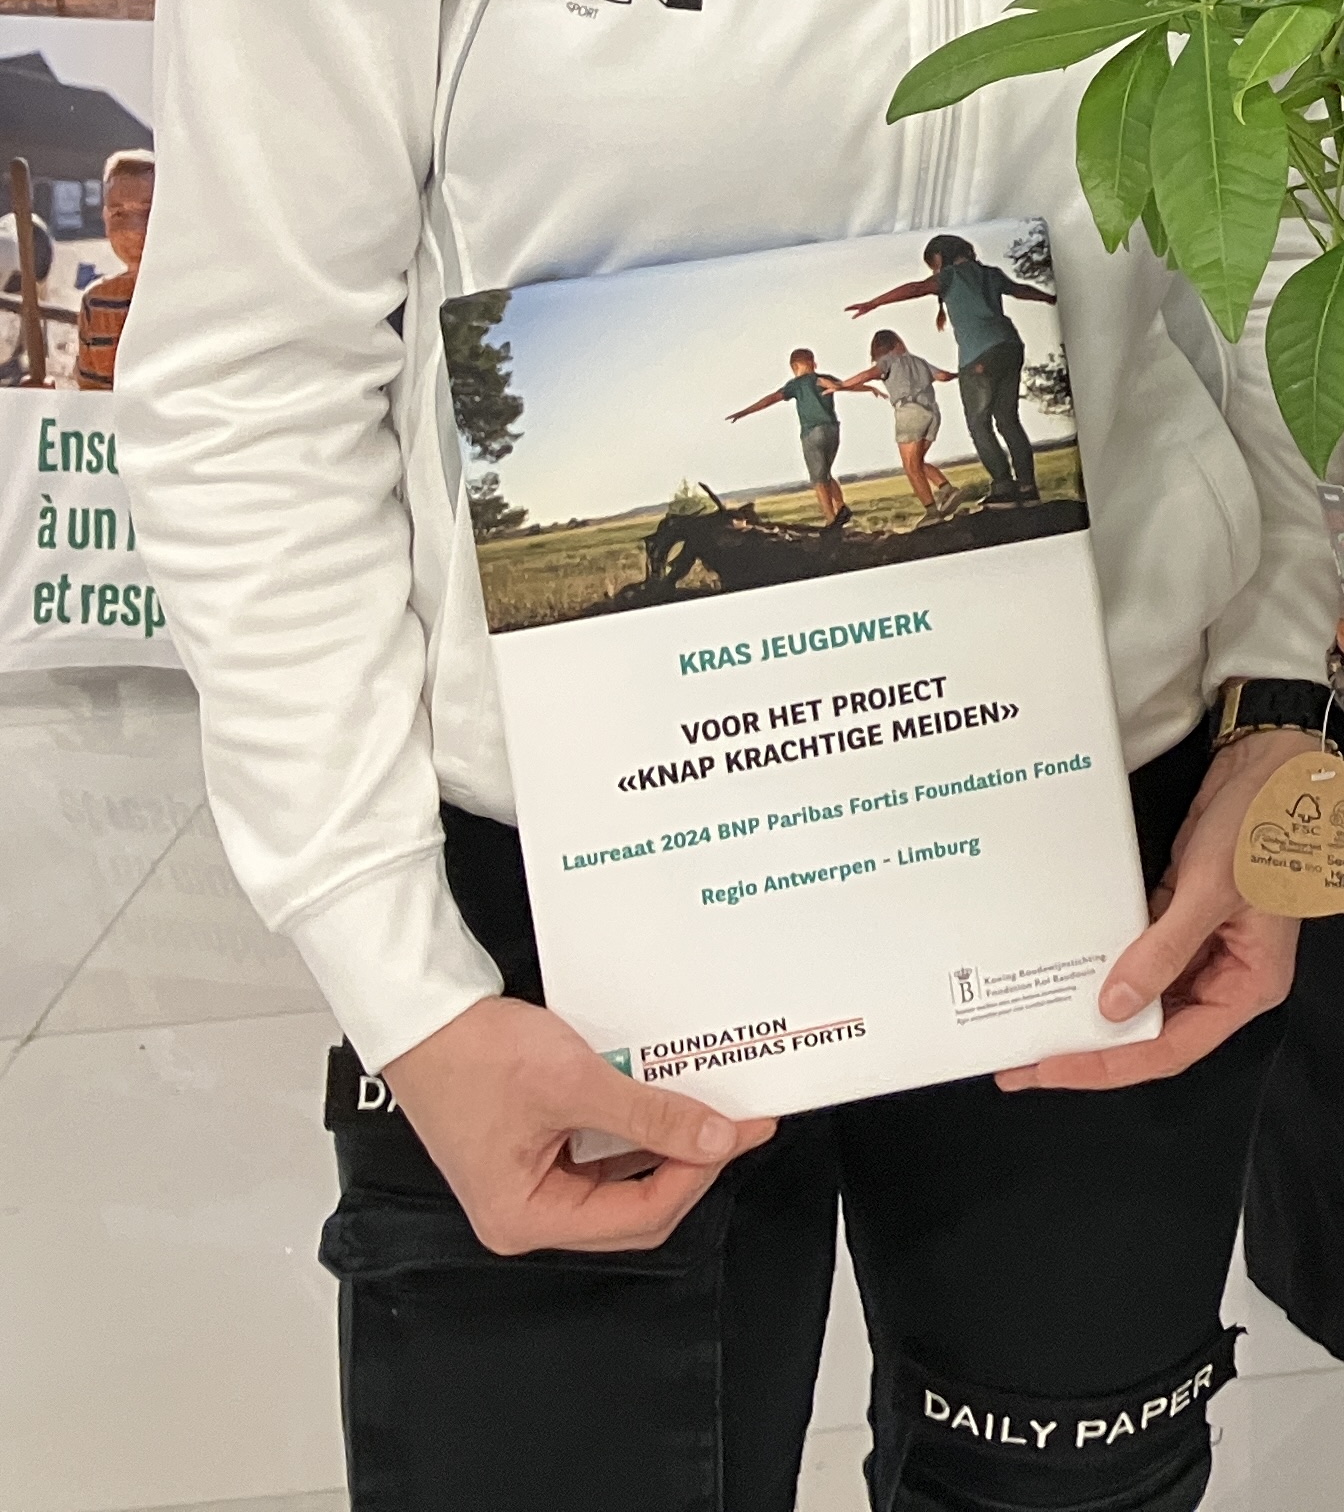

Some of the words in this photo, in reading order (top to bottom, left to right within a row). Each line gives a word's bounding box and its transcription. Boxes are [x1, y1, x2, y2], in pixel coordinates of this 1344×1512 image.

[37, 492, 58, 550] à
[67, 507, 117, 551] un
[33, 573, 72, 626] et
[679, 641, 752, 676] KRAS
[760, 609, 932, 663] JEUGDWERK
[681, 711, 762, 746] VOOR
[768, 698, 823, 732] HET
[832, 675, 948, 718] PROJECT
[617, 755, 716, 794] «KNAP
[725, 724, 885, 775] KRACHTIGE
[892, 701, 1021, 745] MEIDEN»
[562, 837, 656, 872] Laureaat
[661, 826, 712, 854] 2024
[717, 816, 761, 841] BNP
[767, 801, 844, 832] Paribas
[849, 788, 909, 817] Fortis
[915, 766, 1028, 804] Foundation
[1033, 752, 1093, 780] Fonds
[701, 879, 758, 906] Regio
[764, 856, 877, 895] Antwerpen
[897, 835, 982, 868] Limburg
[640, 1017, 788, 1062] FOUNDATION
[643, 1061, 688, 1083] BNP
[695, 1039, 786, 1073] PARIBAS
[793, 1022, 867, 1053] FORTIS
[925, 1389, 1058, 1449] DAILY
[1076, 1363, 1214, 1448] PAPER
